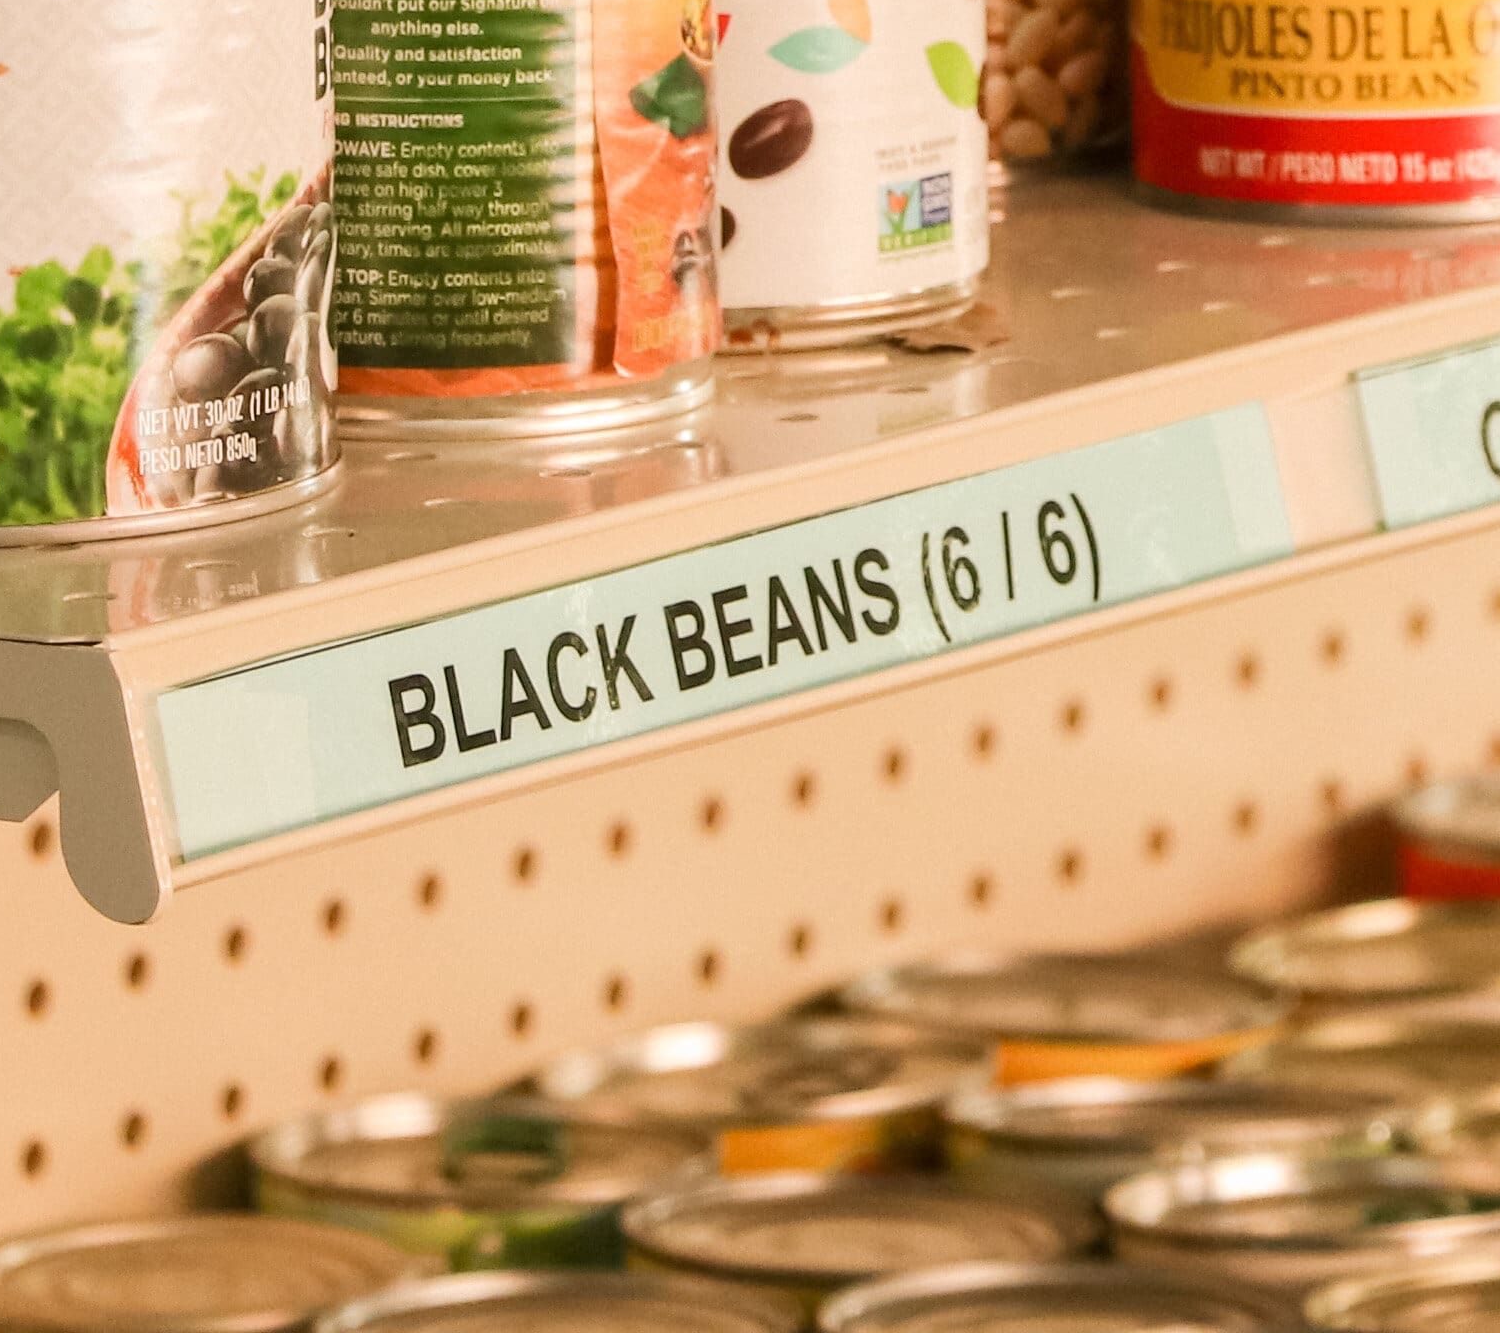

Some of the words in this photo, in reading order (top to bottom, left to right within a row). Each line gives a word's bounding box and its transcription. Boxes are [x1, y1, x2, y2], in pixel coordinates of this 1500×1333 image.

[1328, 7, 1385, 63] DE
[1402, 6, 1457, 61] LA
[395, 46, 424, 62] and
[1230, 68, 1342, 101] PINTO
[1355, 69, 1482, 101] BEANS
[356, 114, 464, 128] INSTRUCTIONS
[138, 407, 170, 437] NET
[173, 403, 200, 437] WT
[204, 400, 222, 427] 30
[227, 395, 244, 423] OZ
[250, 391, 261, 422] (1
[265, 386, 279, 414] LB
[185, 438, 223, 470] NETO
[226, 432, 257, 463] 850g
[388, 612, 654, 771] BLACK
[663, 546, 899, 693] BEANS
[922, 524, 982, 643] (6
[1002, 511, 1017, 602] /
[1038, 491, 1102, 602] 6)
